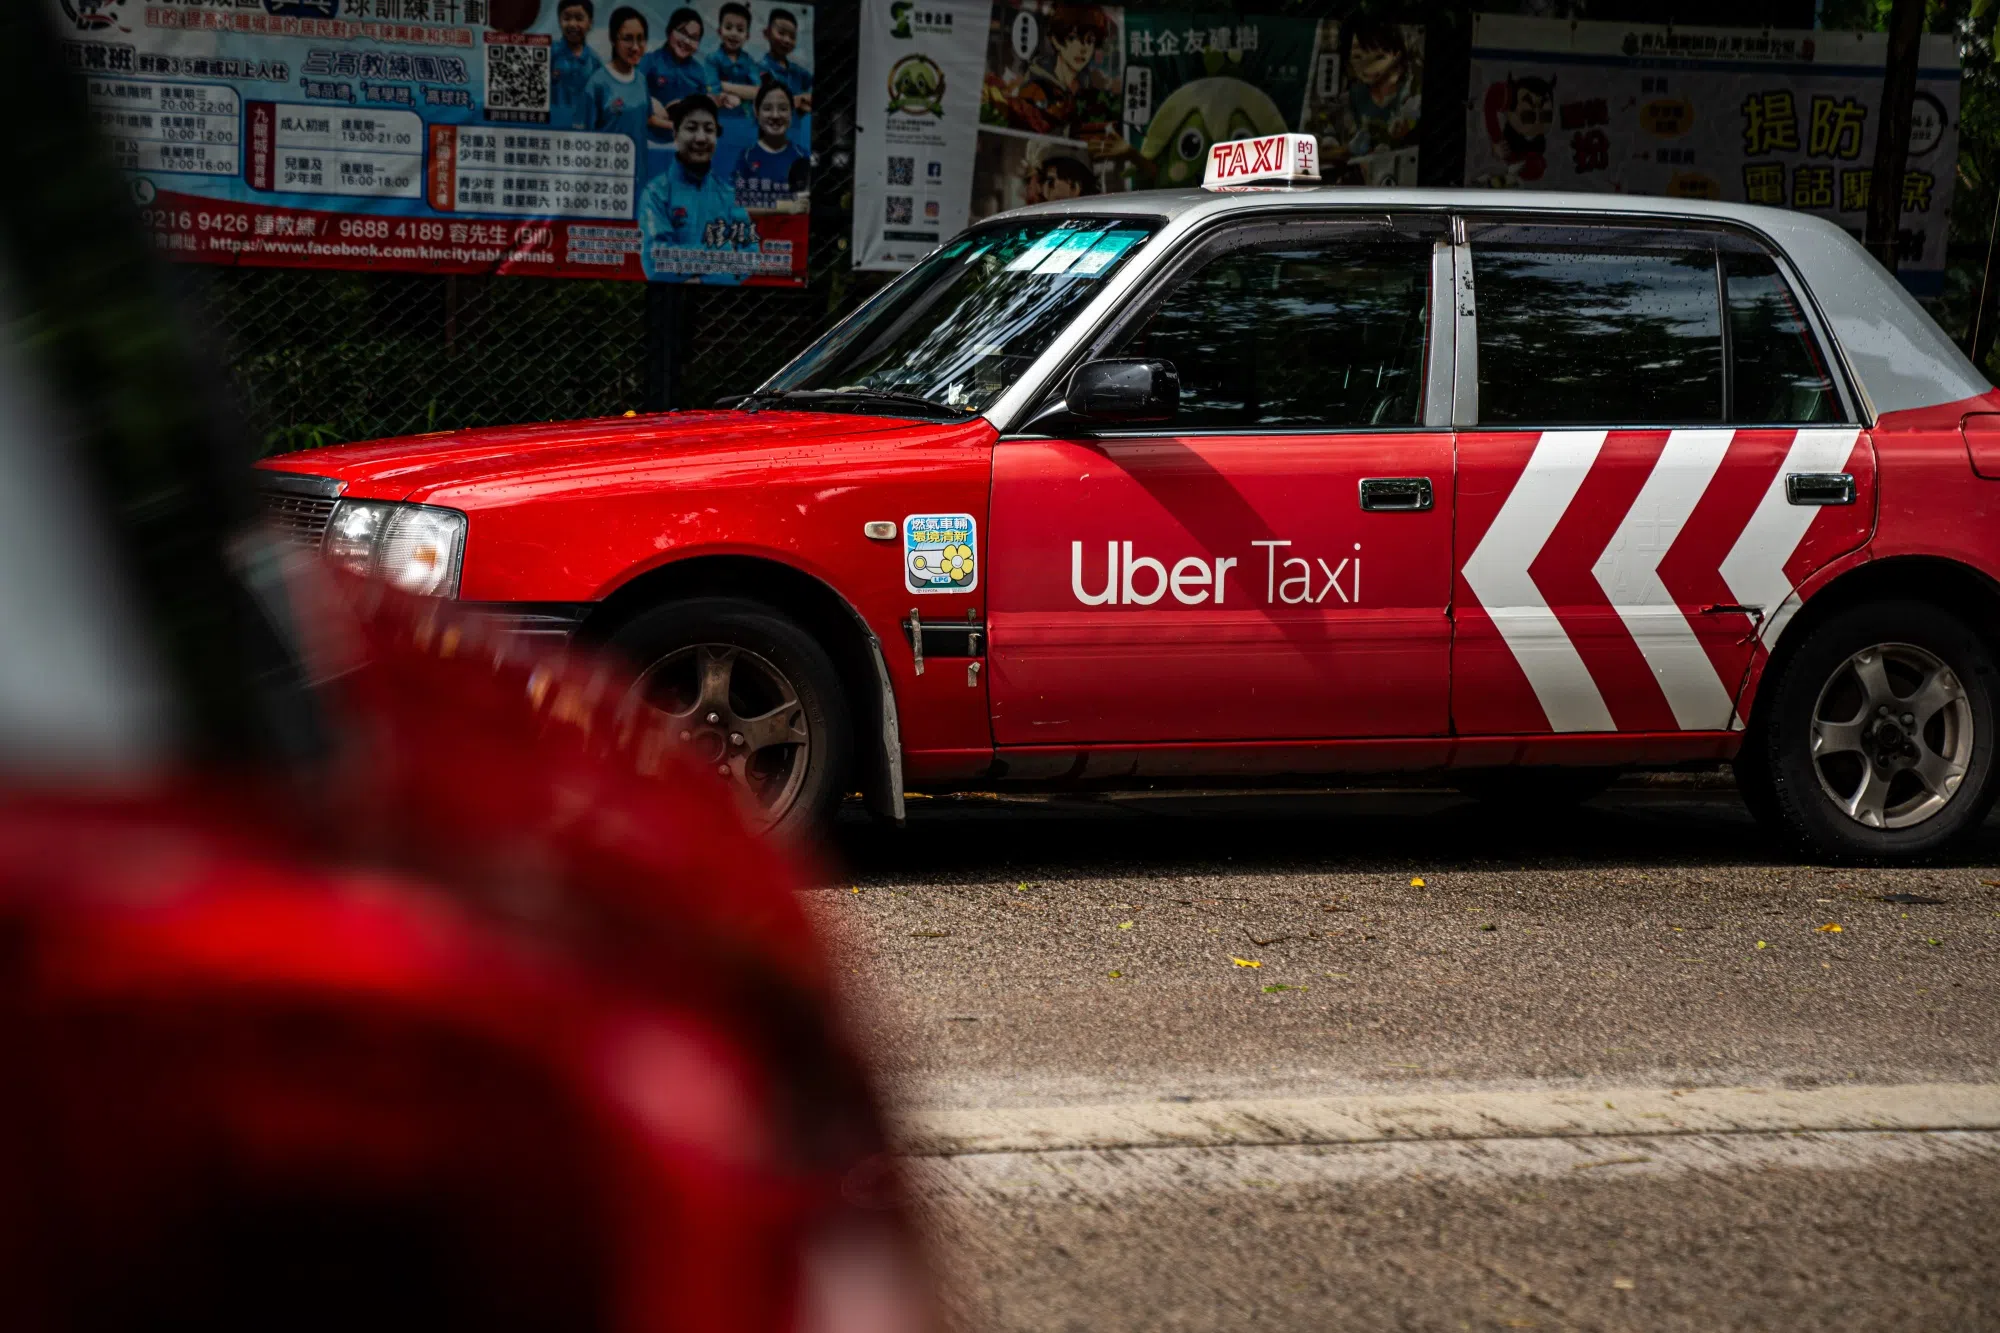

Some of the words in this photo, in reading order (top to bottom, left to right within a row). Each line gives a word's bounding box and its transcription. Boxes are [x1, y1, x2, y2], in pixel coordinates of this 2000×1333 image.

[302, 51, 467, 84] 三高教練團隊
[160, 87, 207, 100] 逢星期三
[160, 100, 233, 114] 20:00-22:00
[160, 116, 206, 130] 逢星期日
[341, 119, 385, 132] 逢星期一
[1743, 92, 1867, 159] 提防
[162, 129, 233, 143] 10:00-12:00
[341, 131, 411, 145] 19:00-21:00
[504, 136, 551, 151] 逢星期五
[556, 140, 630, 154] 18:00-20:00
[160, 146, 205, 159] 逢星期日
[1213, 137, 1285, 178] TAXI
[1298, 140, 1314, 168] 的士
[161, 159, 233, 172] 12:00-16:00
[504, 153, 550, 167] 逢星期六
[556, 156, 629, 170] 15:00-21:00
[340, 162, 385, 176] 逢星期一
[340, 175, 410, 189] 16:00-18:00
[503, 178, 550, 193] 逢星期五
[554, 181, 628, 196] 20:00-22:00
[1743, 163, 1935, 212] 電話騙案
[502, 195, 550, 210] 逢星期六
[555, 198, 628, 212] 13:00-15:00
[142, 209, 193, 230] 9216
[197, 211, 249, 232] 9426
[338, 219, 390, 240] 9688
[395, 221, 444, 242] 4189
[449, 224, 508, 246] 容先生
[513, 226, 554, 250] (Bill)
[911, 517, 969, 532] 燃氣車輛
[913, 530, 968, 543] 環境清新
[1071, 540, 1238, 606] Uber
[1251, 540, 1362, 605] Taxi
